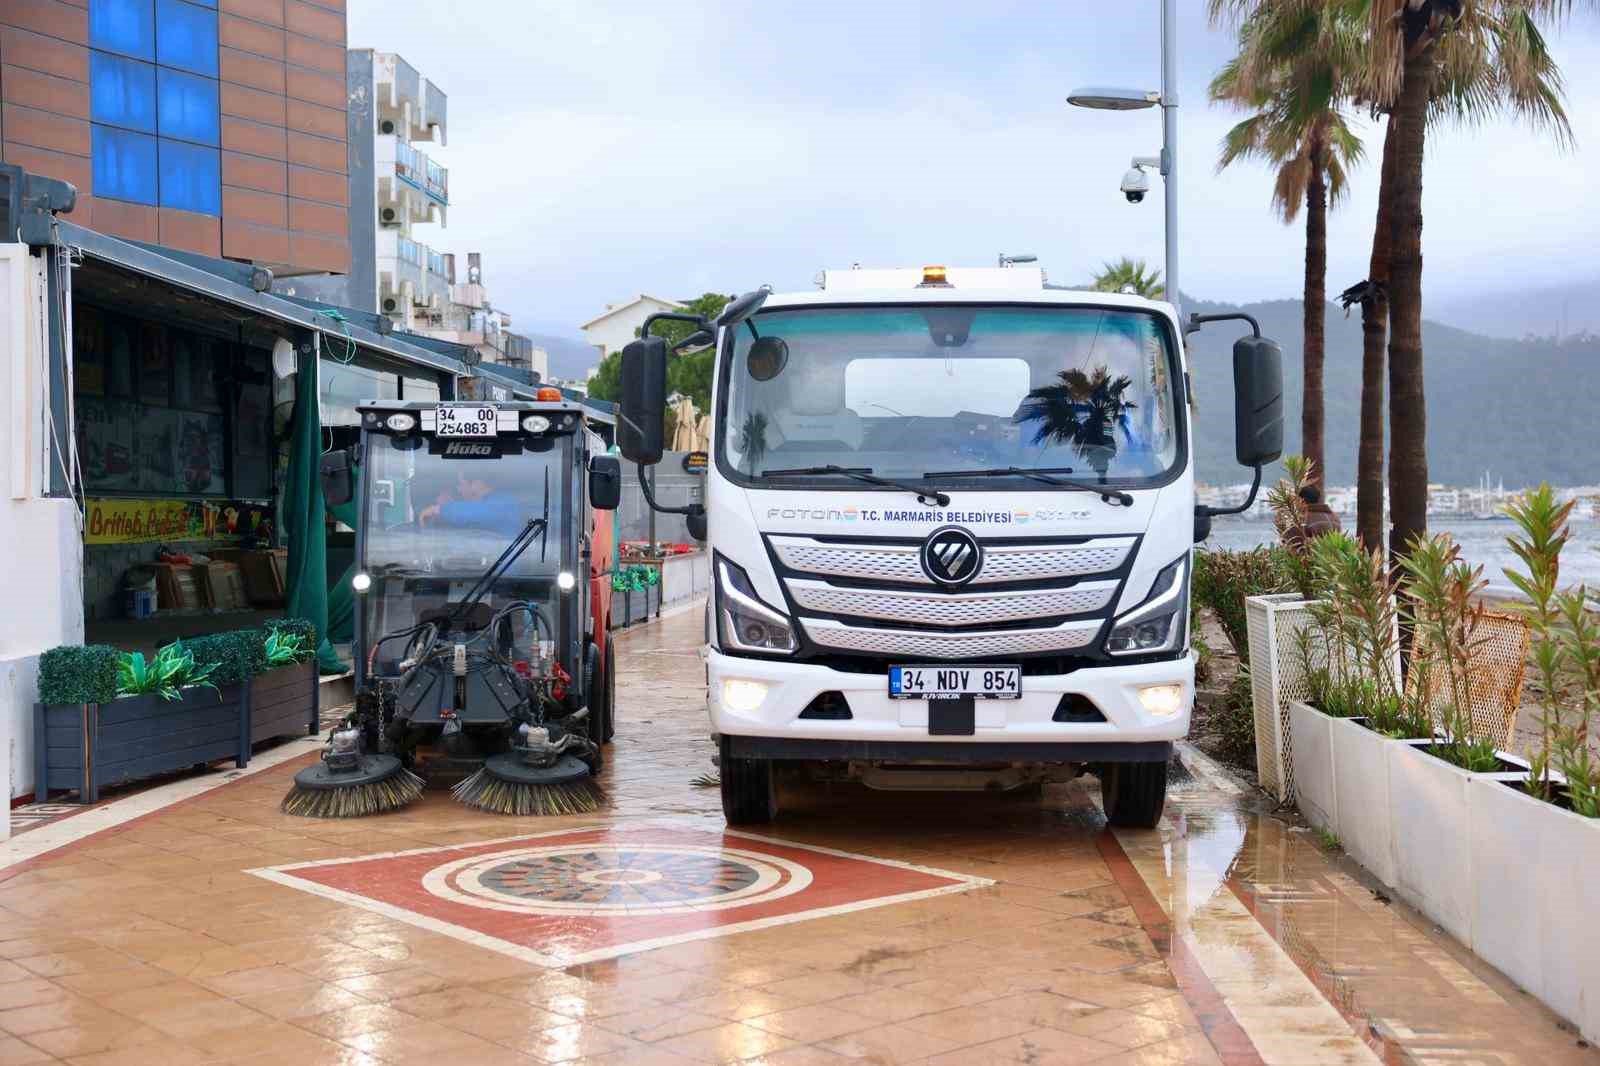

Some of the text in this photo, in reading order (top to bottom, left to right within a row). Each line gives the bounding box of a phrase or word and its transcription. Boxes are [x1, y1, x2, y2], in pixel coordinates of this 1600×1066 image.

[439, 409, 494, 421] 34 00
[446, 441, 492, 454] Hako
[861, 508, 1012, 523] T.C. MARMARİS BELEDİYESİ
[903, 670, 925, 690] 34
[937, 670, 970, 690] NDV
[983, 670, 1016, 691] 854
